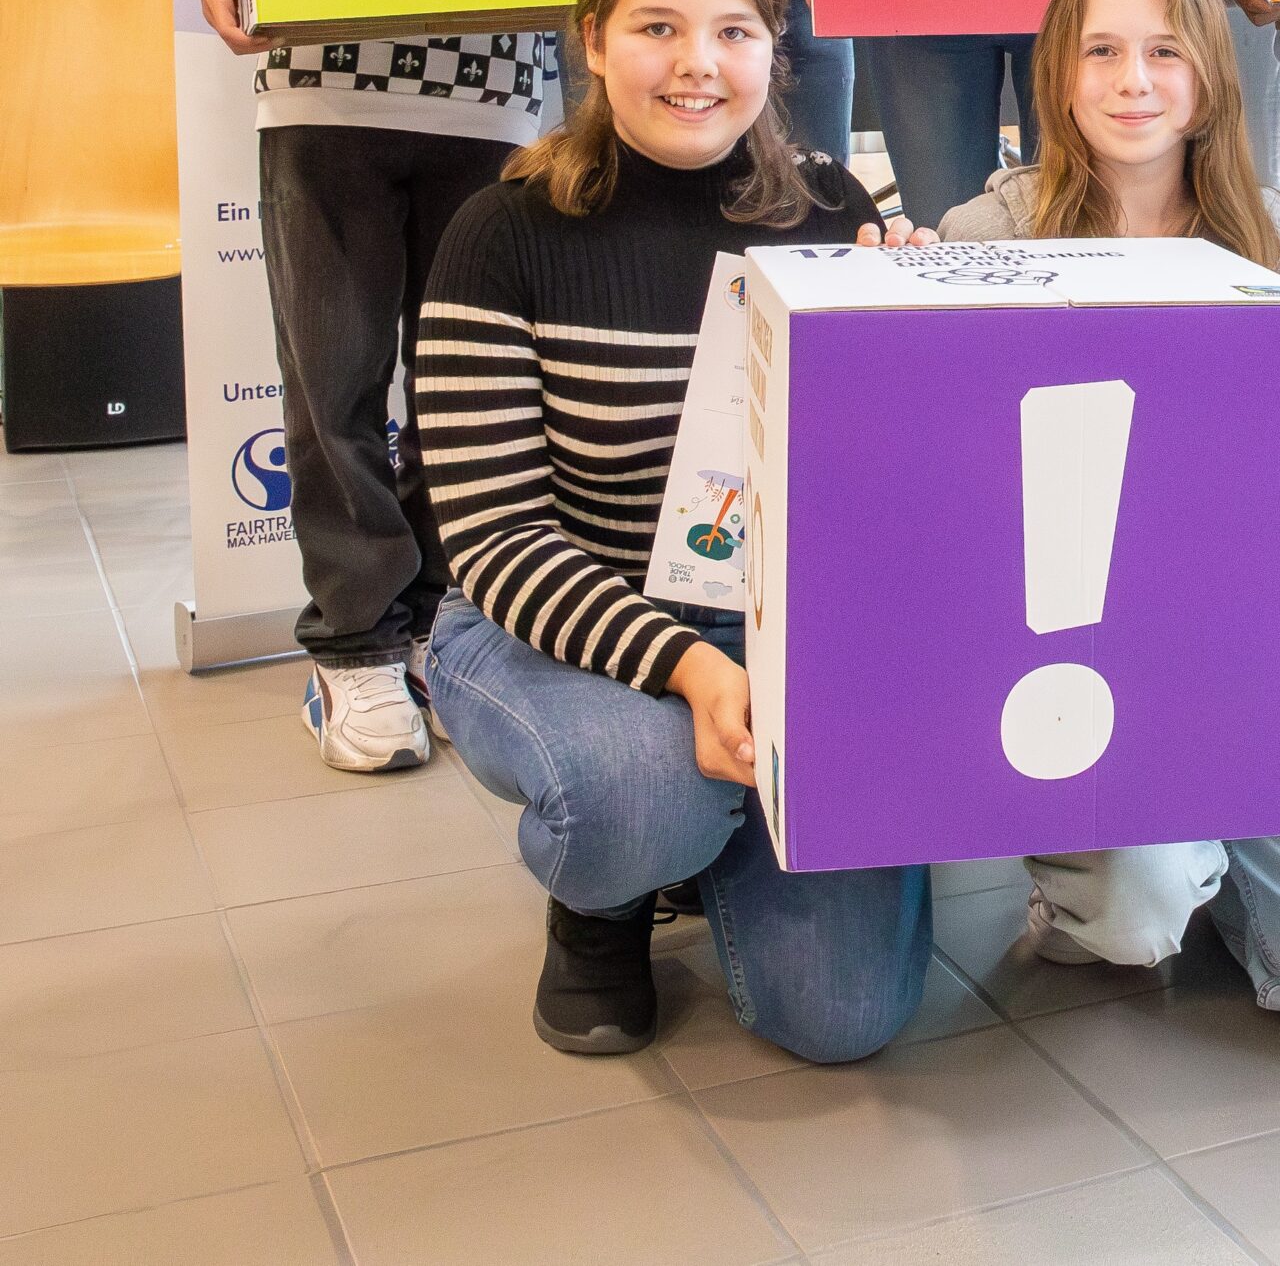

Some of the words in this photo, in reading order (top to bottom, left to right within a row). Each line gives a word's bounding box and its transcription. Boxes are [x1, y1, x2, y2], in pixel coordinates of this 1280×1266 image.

[217, 202, 250, 222] Ein
[789, 247, 853, 259] 17
[226, 535, 257, 549] MAX
